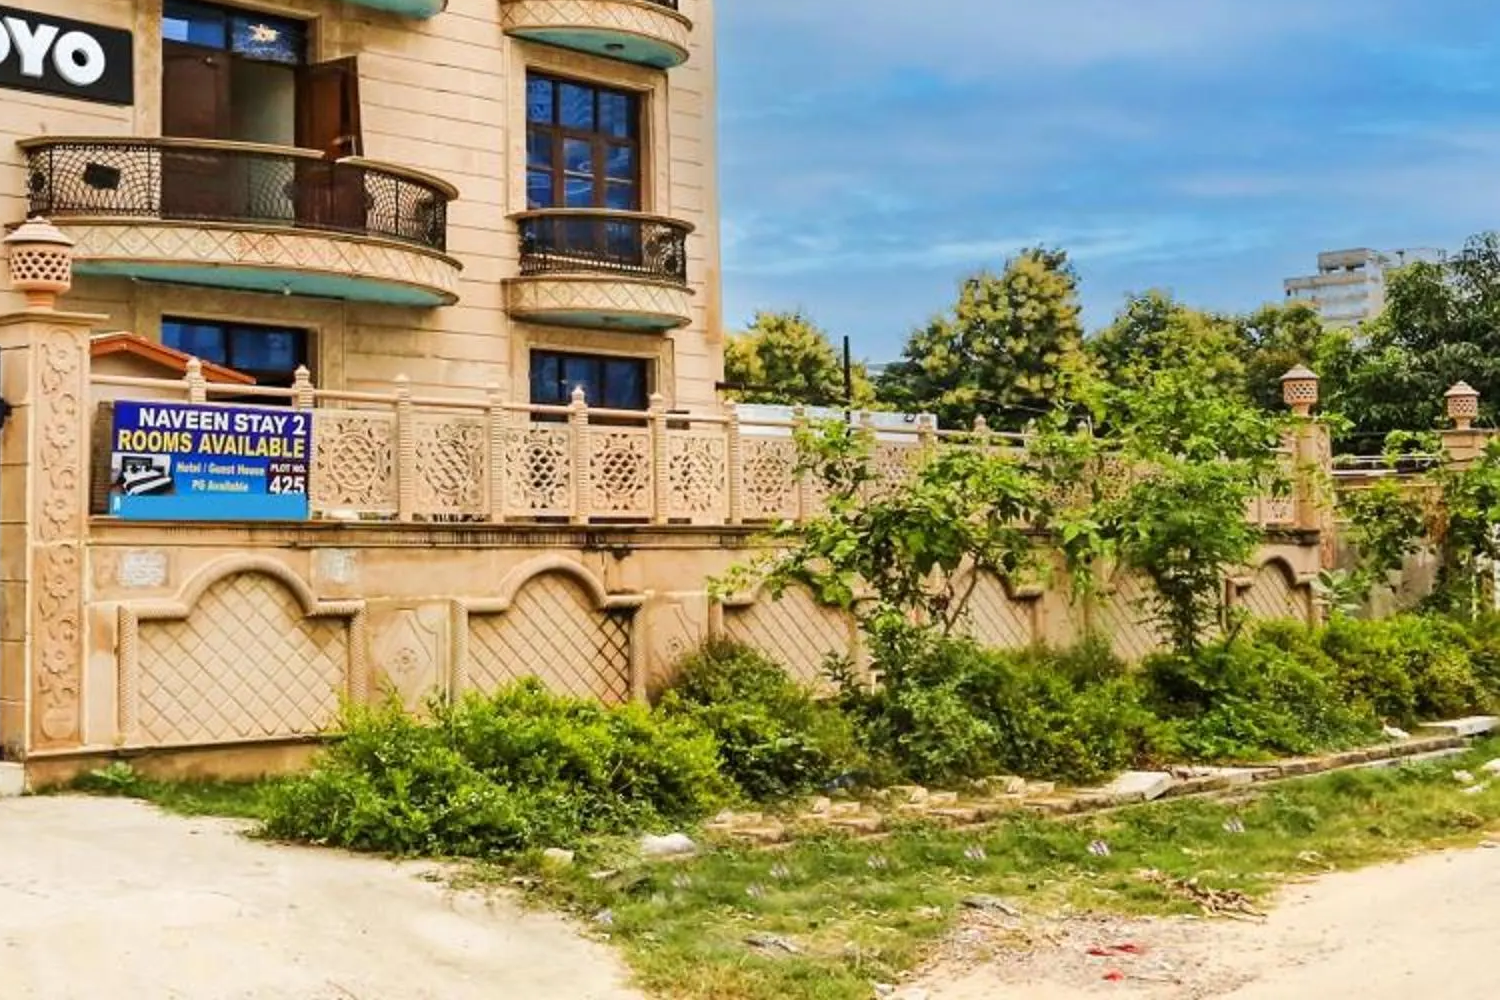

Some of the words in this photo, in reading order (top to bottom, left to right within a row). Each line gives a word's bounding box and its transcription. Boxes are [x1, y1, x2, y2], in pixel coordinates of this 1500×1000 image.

[139, 407, 229, 432] NAVEEN
[234, 413, 287, 434] STAY
[292, 416, 306, 435] 2
[118, 430, 192, 453] ROOMS
[198, 434, 304, 458] AVAILABLE
[269, 463, 290, 473] PLOT
[208, 481, 248, 492] Available
[269, 475, 305, 494] 425
